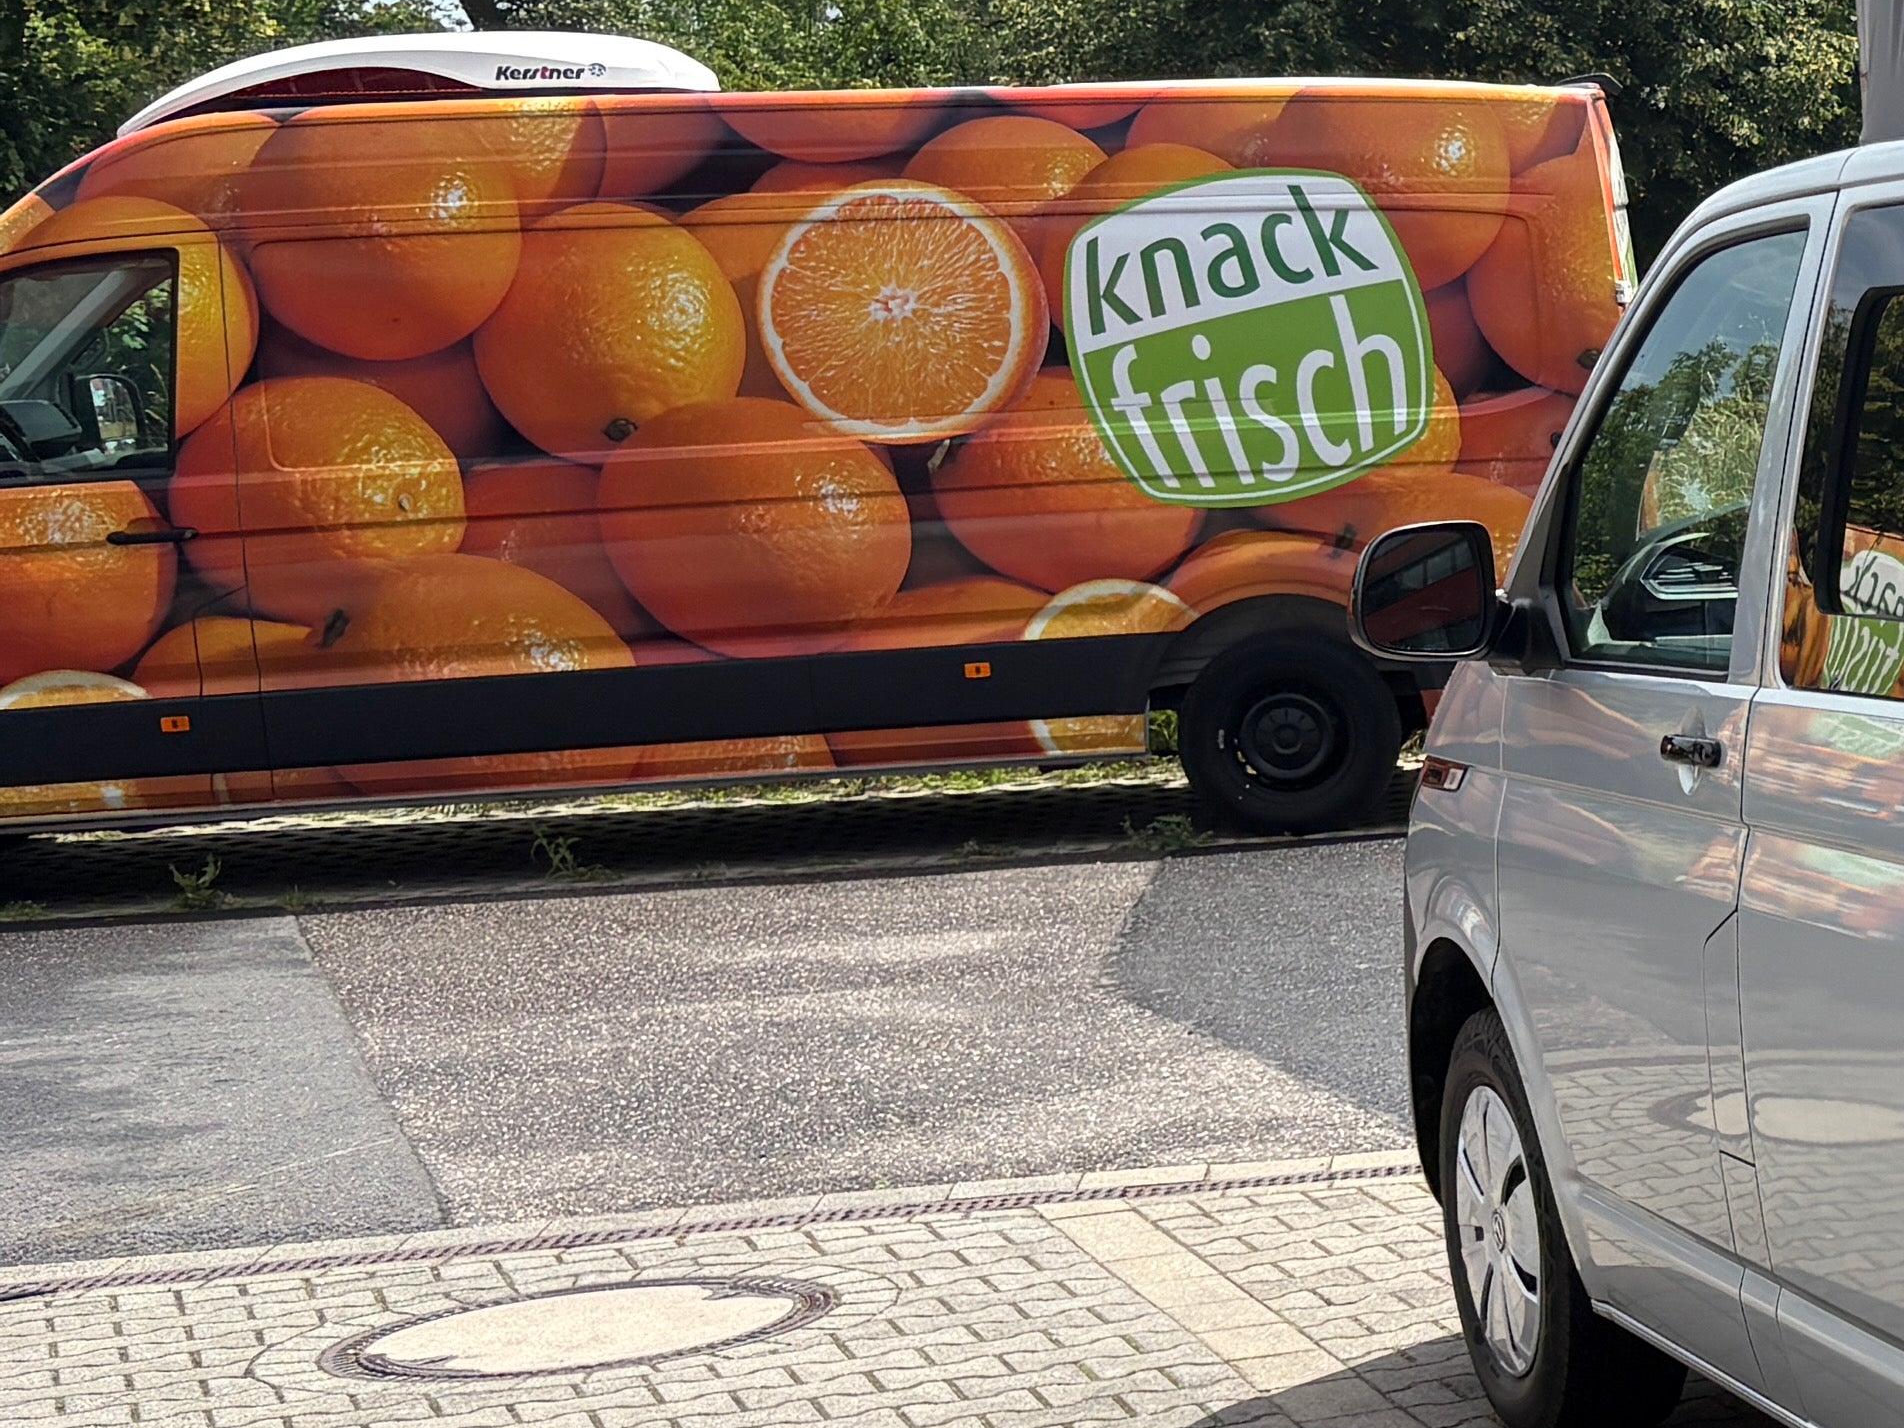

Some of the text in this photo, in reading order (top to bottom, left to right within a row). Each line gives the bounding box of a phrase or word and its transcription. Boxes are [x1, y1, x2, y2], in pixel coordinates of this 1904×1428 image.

[494, 65, 586, 81] Kerstner
[1084, 184, 1380, 337] knack
[1110, 294, 1408, 489] frisch
